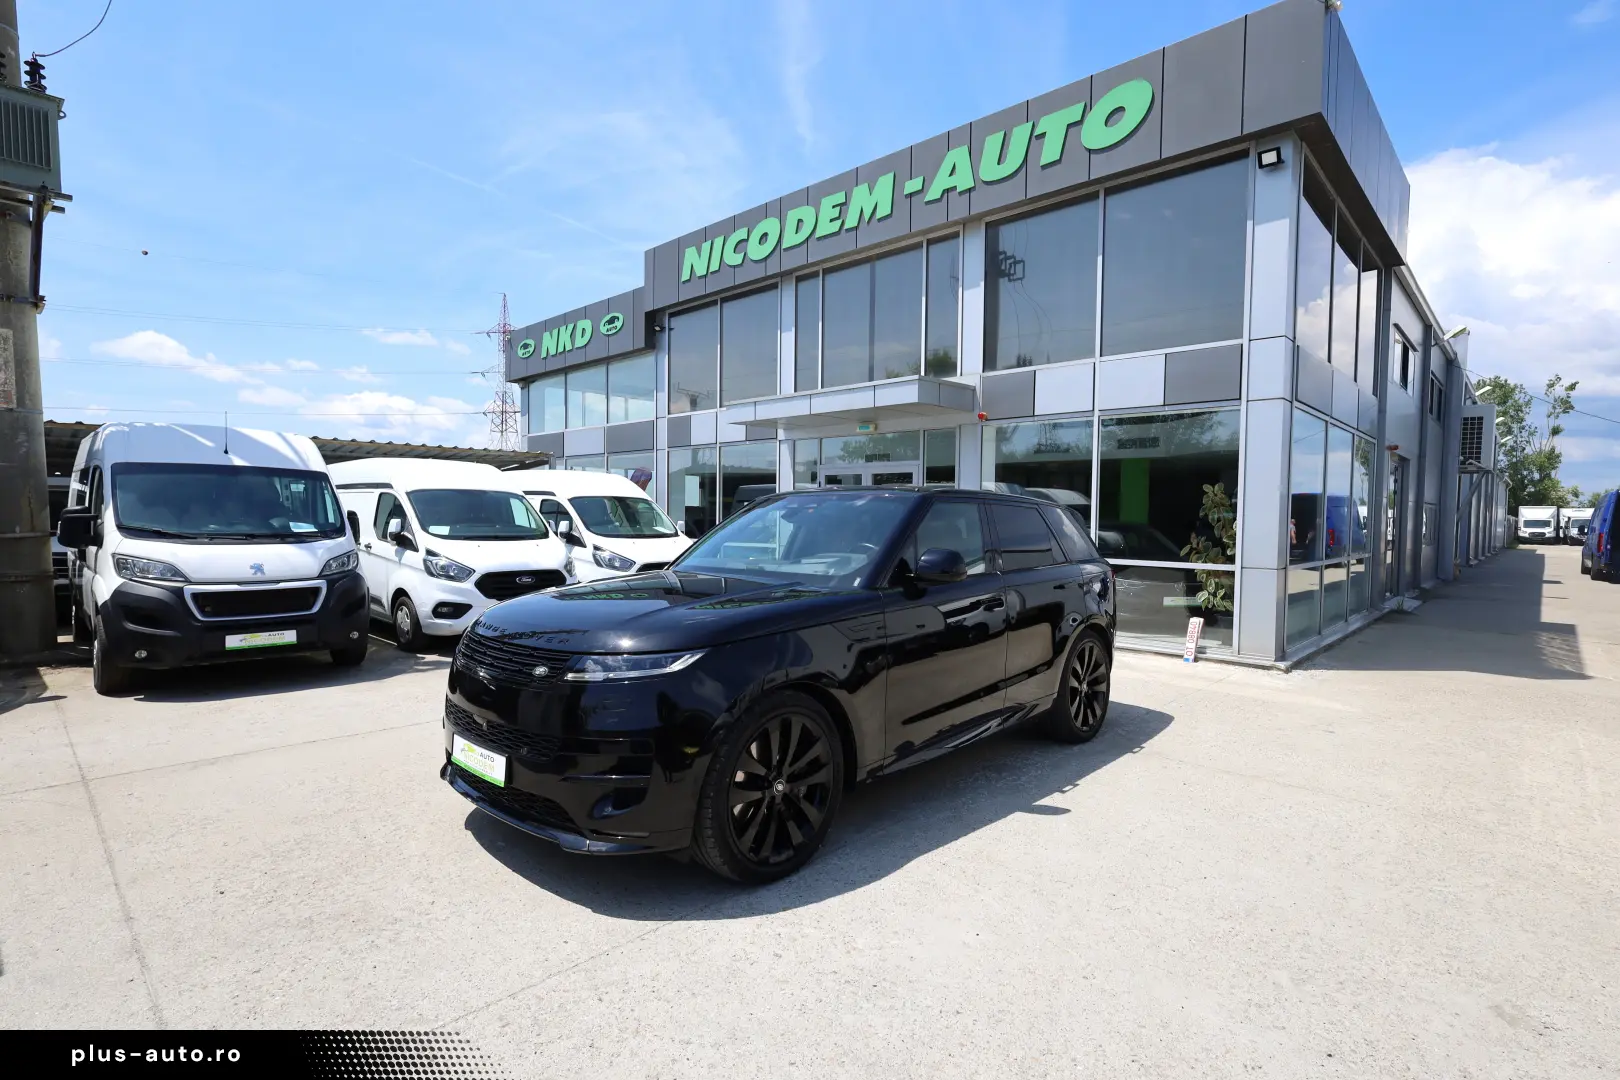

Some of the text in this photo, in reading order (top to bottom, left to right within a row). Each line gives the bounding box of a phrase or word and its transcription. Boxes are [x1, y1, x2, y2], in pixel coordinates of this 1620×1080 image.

[605, 325, 618, 333] AUTO
[541, 319, 593, 359] NKD
[479, 752, 495, 763] AUTO
